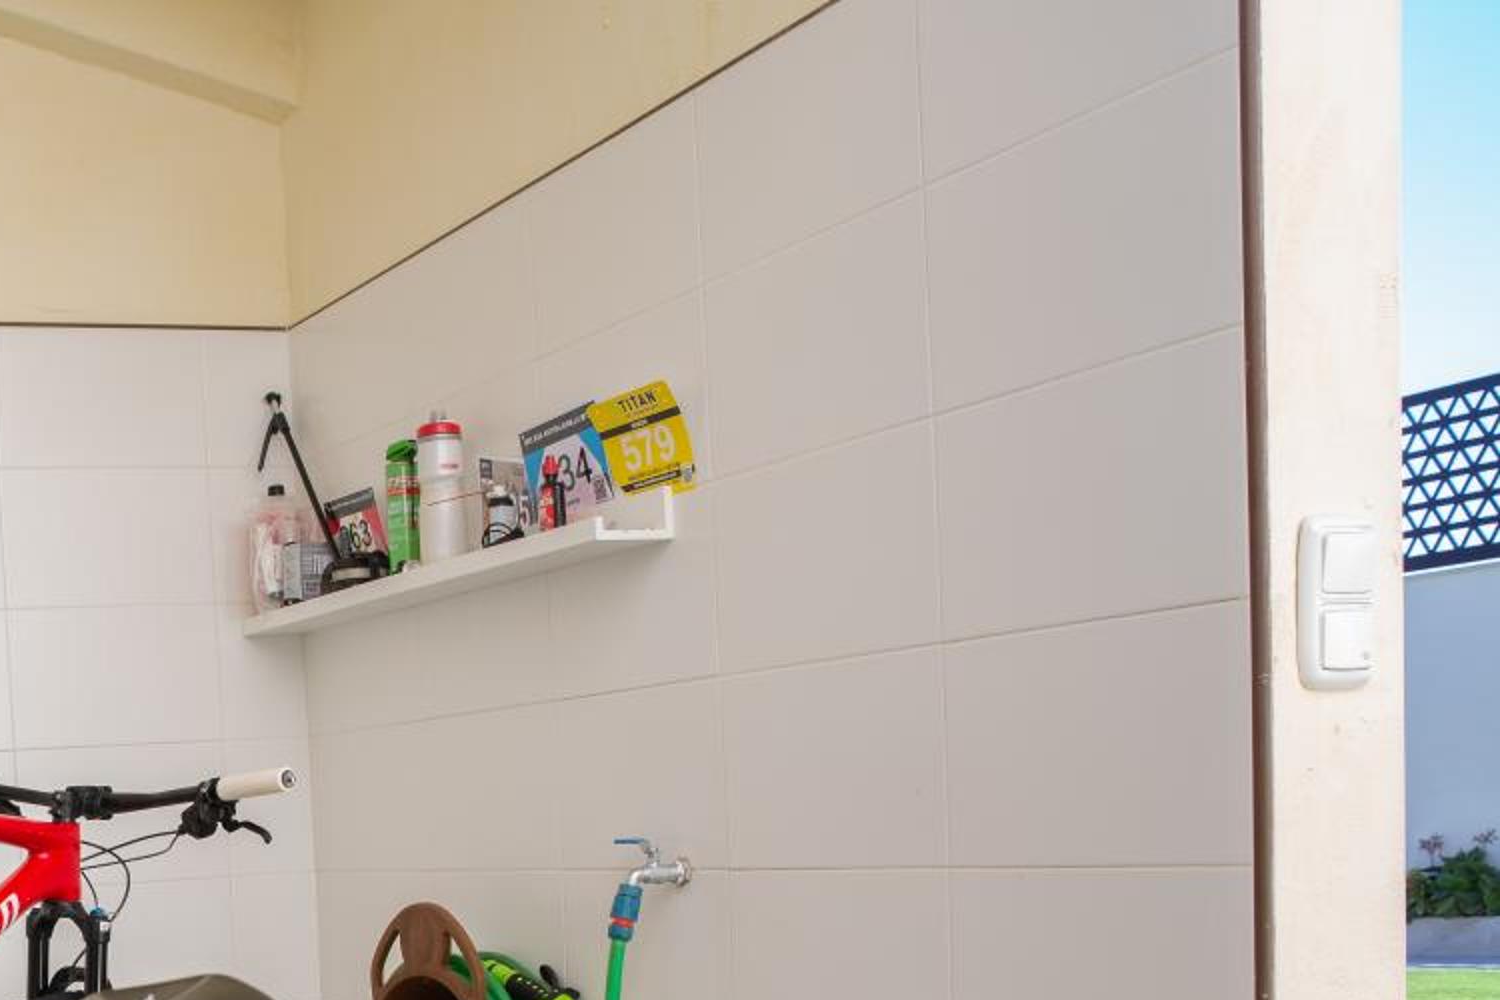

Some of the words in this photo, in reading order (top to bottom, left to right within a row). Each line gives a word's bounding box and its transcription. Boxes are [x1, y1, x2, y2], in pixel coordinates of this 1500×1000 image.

[618, 391, 658, 413] TITAN
[557, 446, 593, 492] 34
[619, 424, 676, 473] 579
